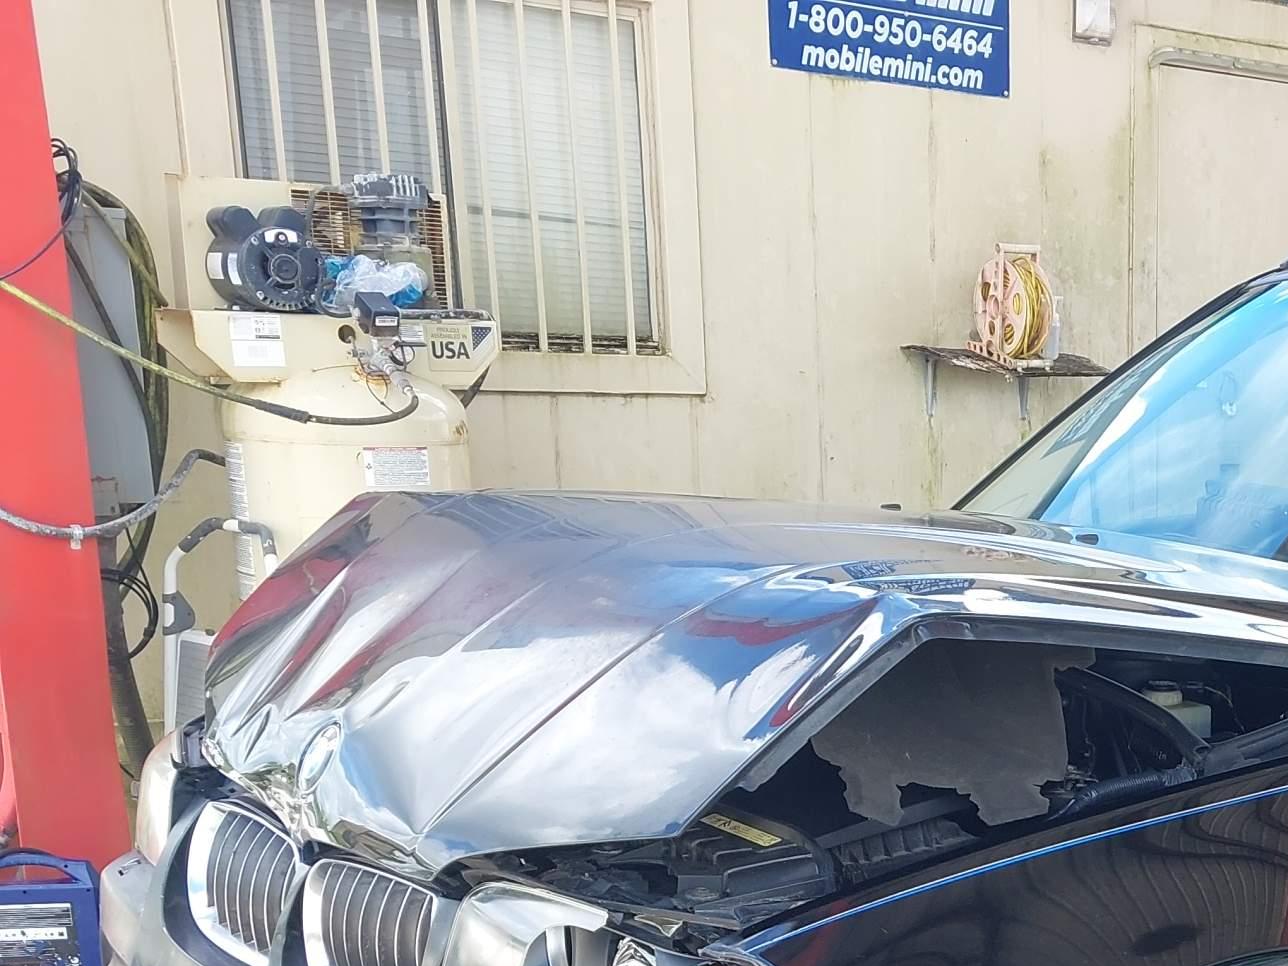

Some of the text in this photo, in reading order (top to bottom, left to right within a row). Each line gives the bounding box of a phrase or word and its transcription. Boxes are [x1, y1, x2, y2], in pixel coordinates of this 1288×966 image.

[787, 0, 993, 58] 1-800-950-6464
[801, 43, 984, 90] mobilemini.com
[431, 340, 470, 359] USA
